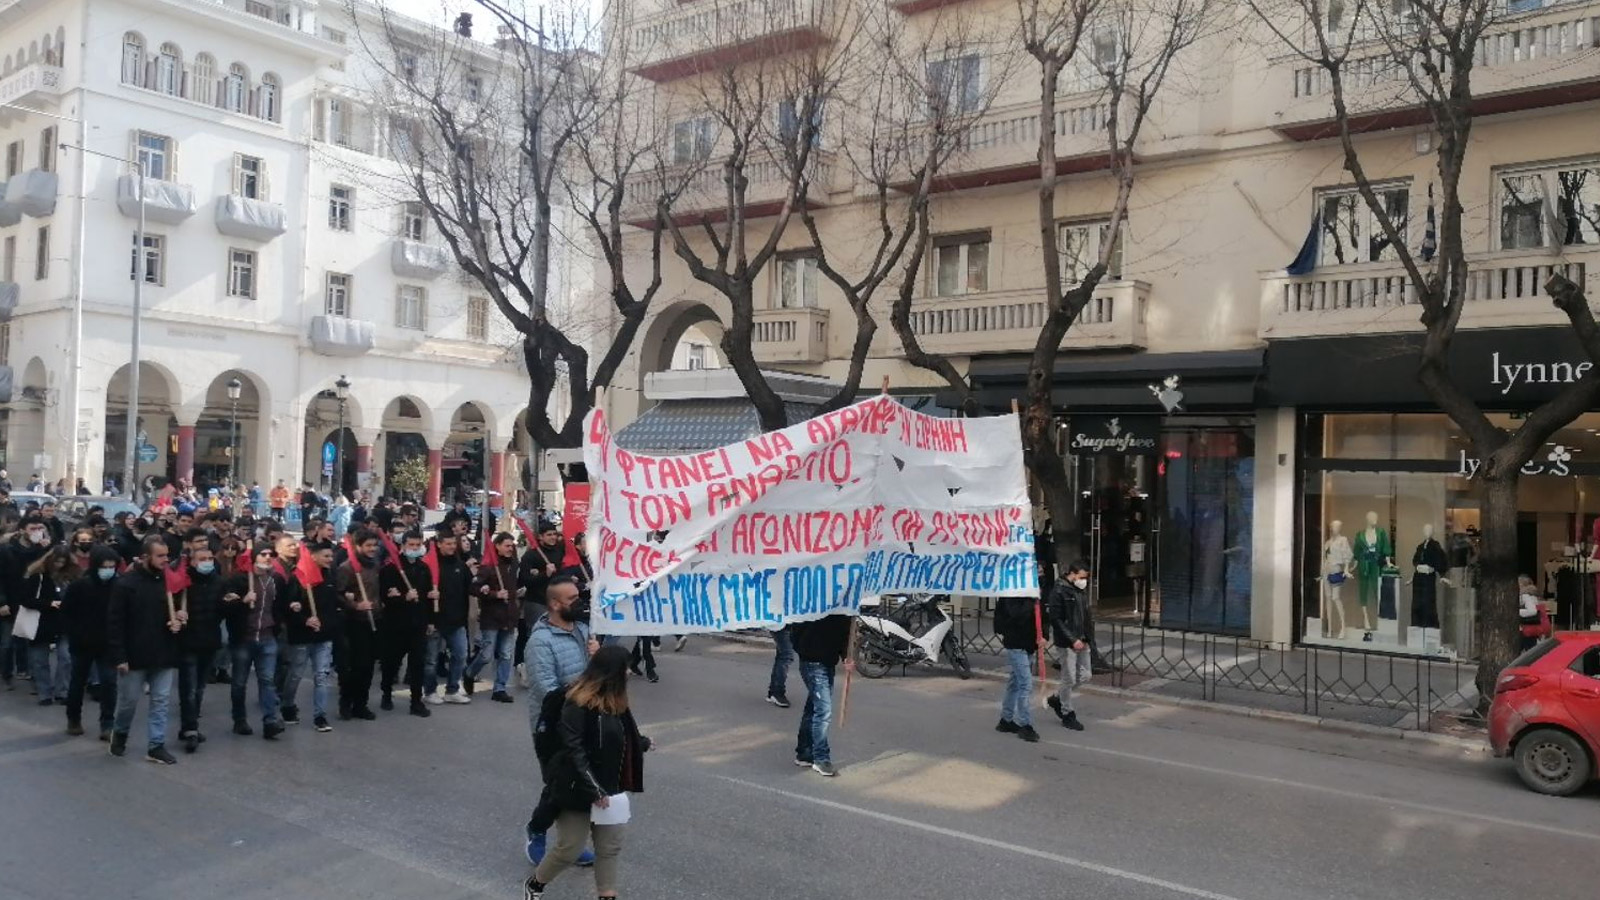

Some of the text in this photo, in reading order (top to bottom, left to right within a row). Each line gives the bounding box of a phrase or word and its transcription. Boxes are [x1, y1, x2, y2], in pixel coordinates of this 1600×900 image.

[1491, 351, 1594, 394] lynne
[745, 432, 793, 467] ΝΑ
[1071, 432, 1156, 452] Sugarfree
[620, 490, 692, 531] ΤΟΝ
